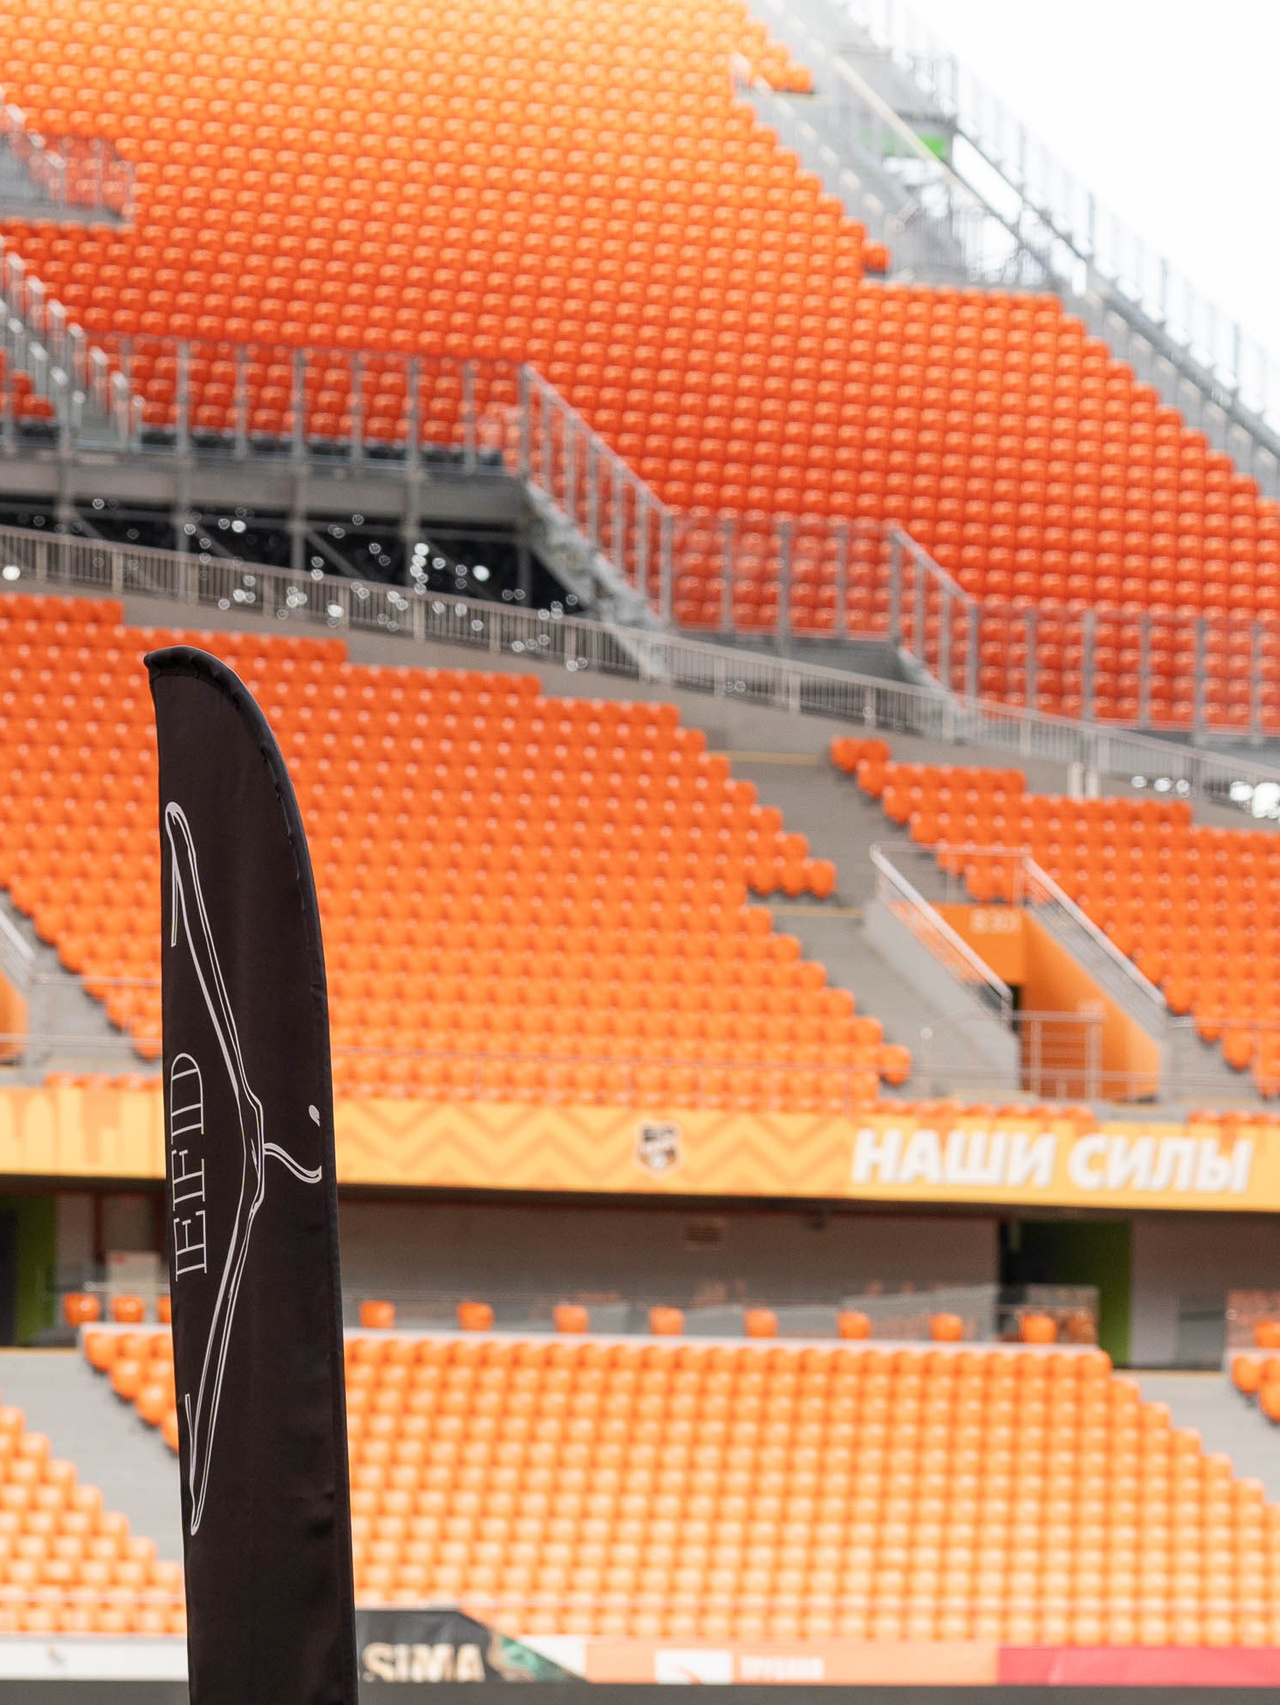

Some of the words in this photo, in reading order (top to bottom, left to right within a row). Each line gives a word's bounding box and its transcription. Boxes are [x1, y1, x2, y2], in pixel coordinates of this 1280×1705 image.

[170, 1052, 207, 1282] EFD
[851, 1128, 1058, 1188] НАШИ
[1067, 1133, 1254, 1193] СИЛЫ
